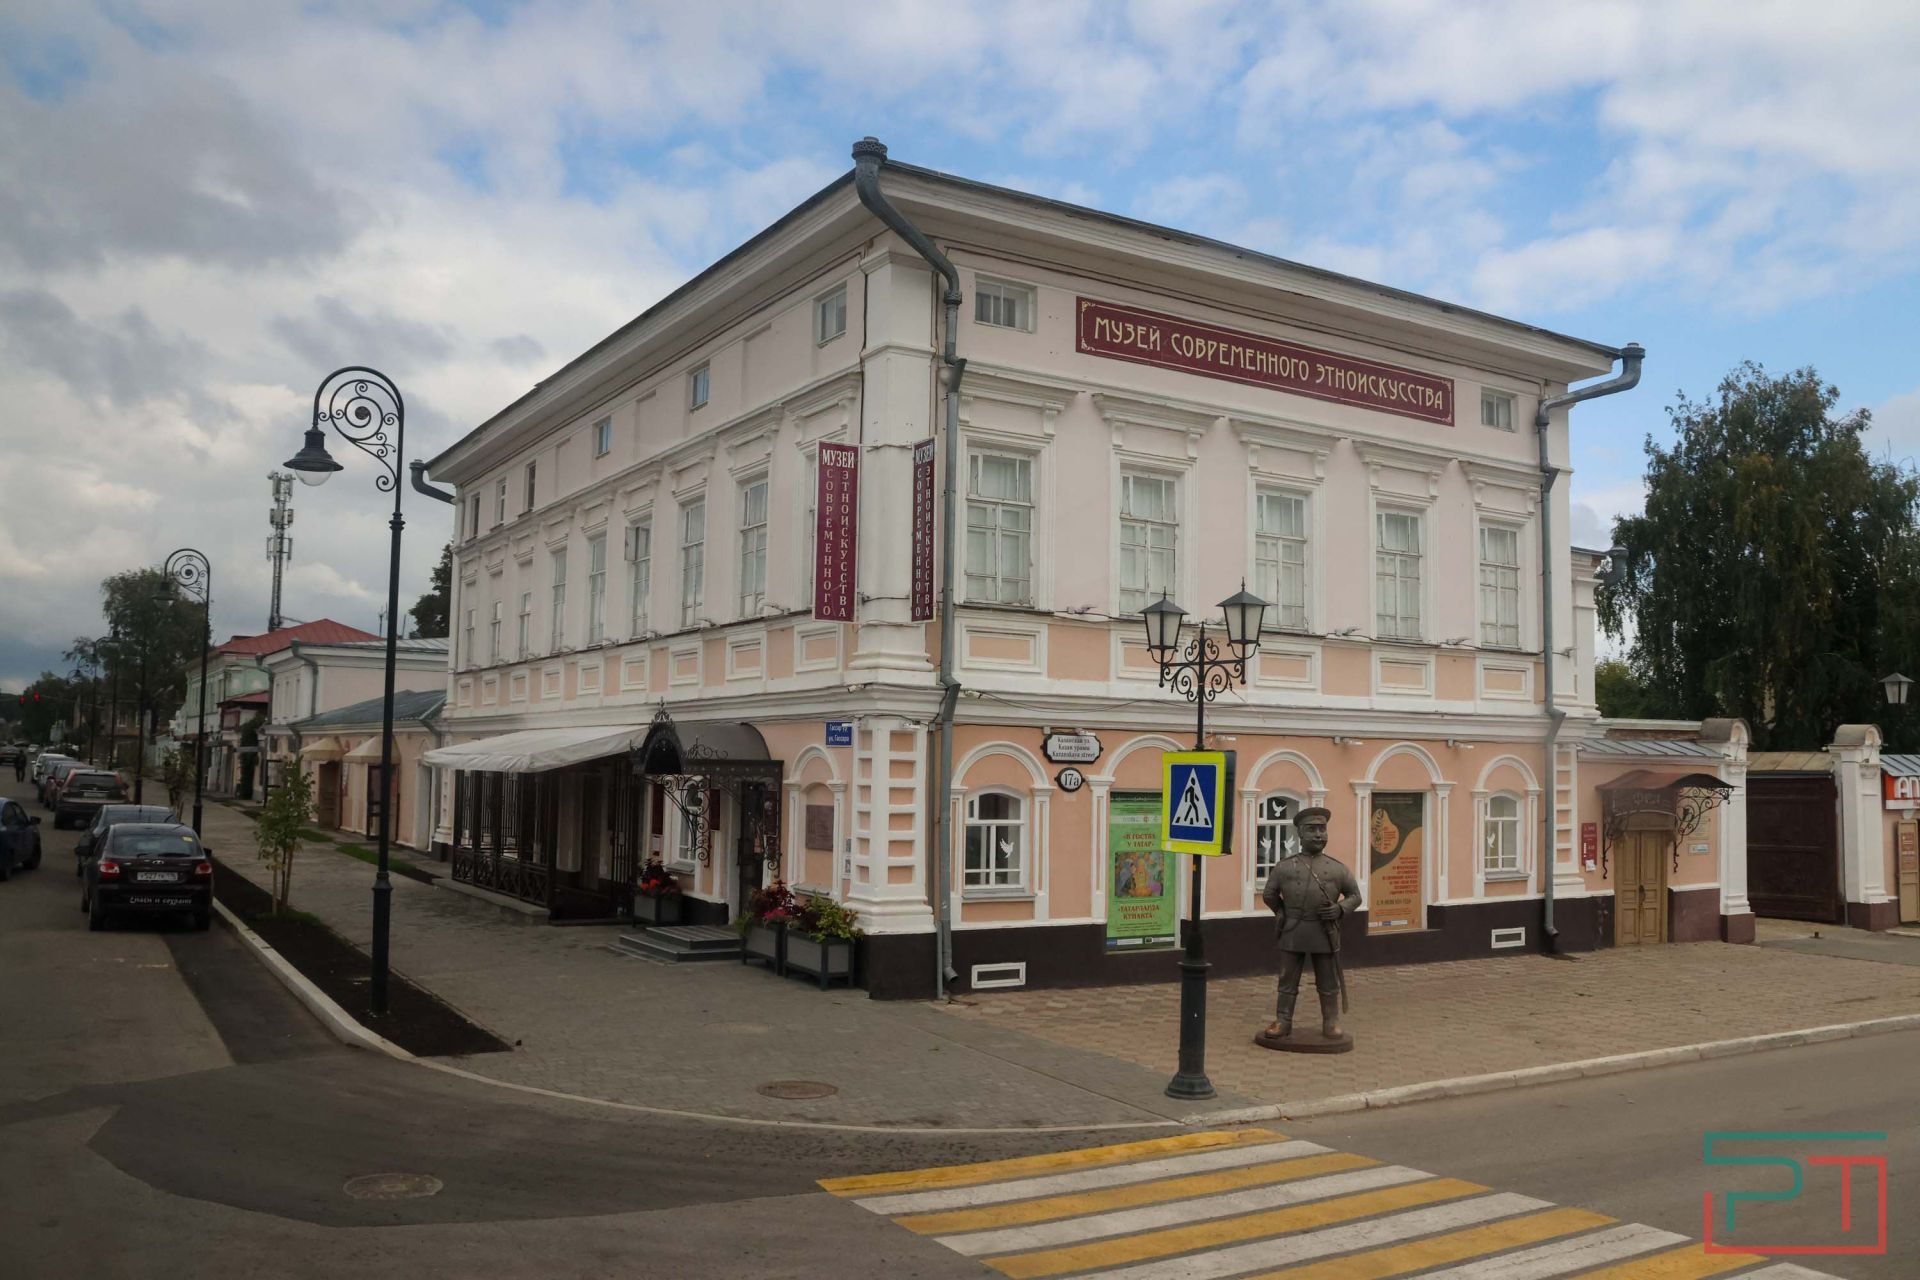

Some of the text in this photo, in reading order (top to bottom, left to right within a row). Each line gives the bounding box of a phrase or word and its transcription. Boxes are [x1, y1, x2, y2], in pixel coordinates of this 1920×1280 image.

[1094, 317, 1443, 410] МУЗЕЙ СОВРЕМЕННОГО ЭТНОИСКУССТВА
[822, 449, 855, 468] МУЗЕЙ
[915, 443, 934, 465] МУЗЕЙ
[822, 468, 834, 616] СОВРЕМЕННОГО
[838, 470, 849, 617] ЭТНОИСКУССТВА
